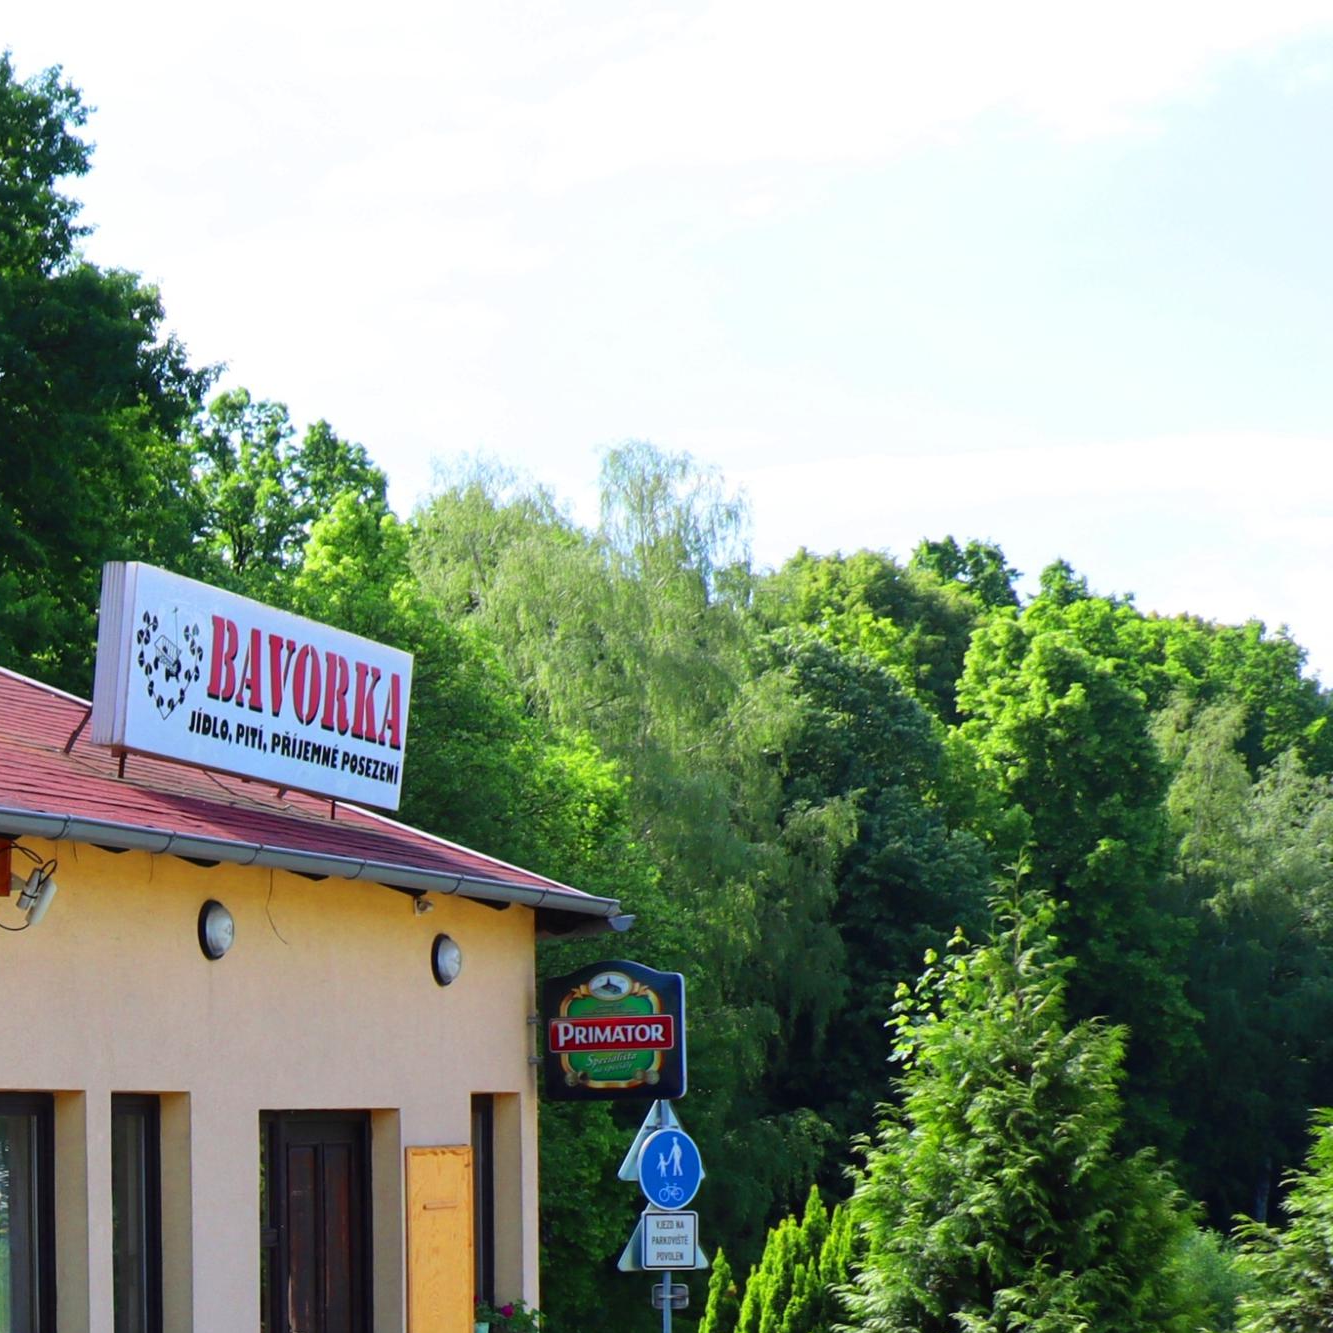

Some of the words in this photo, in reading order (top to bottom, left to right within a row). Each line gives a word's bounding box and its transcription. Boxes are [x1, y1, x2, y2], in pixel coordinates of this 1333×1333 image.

[207, 615, 401, 750] BAVORKA
[188, 708, 232, 745] JÍDLO,
[236, 724, 267, 754] PITÍ,
[271, 731, 337, 769] PŘÍJEMNÉ
[341, 751, 399, 785] POSEZENÍ
